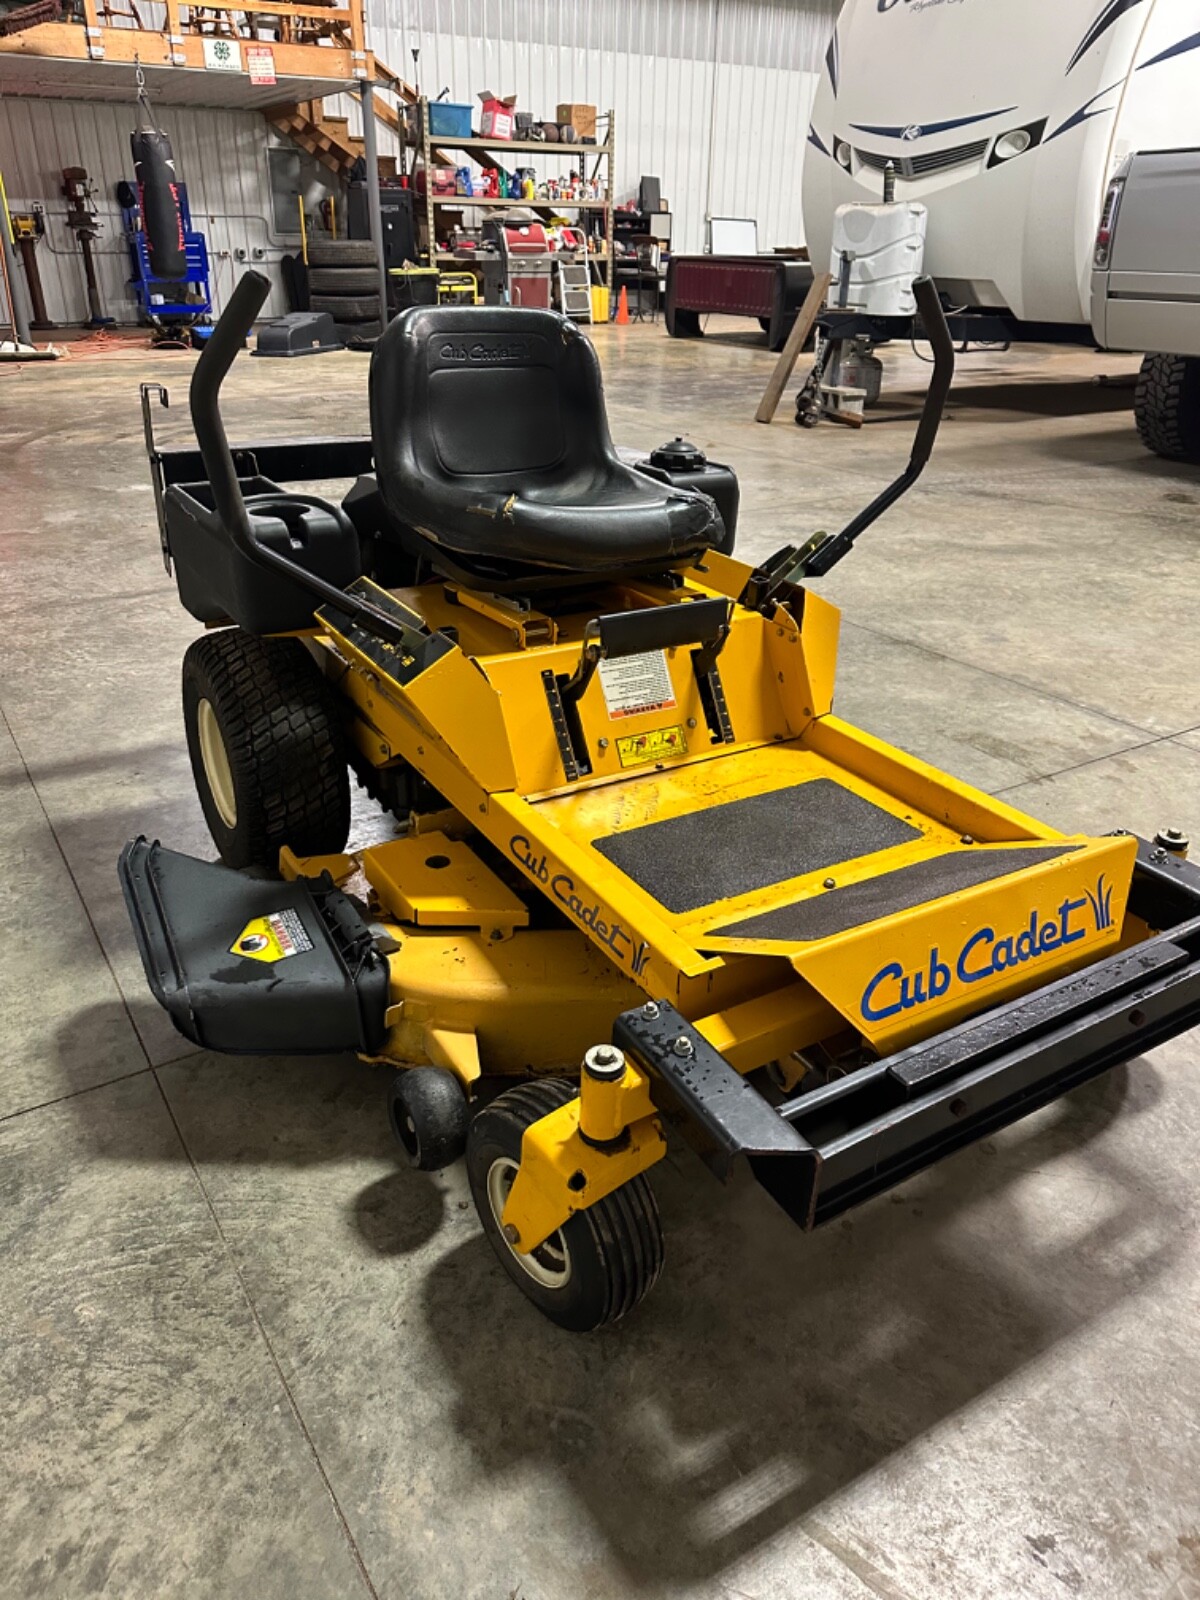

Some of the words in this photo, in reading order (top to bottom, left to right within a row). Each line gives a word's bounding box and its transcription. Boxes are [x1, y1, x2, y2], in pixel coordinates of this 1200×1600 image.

[510, 834, 549, 884] Cub
[551, 874, 631, 959] Cadet
[860, 947, 952, 1022] Cub
[956, 898, 1088, 984] Cadet
